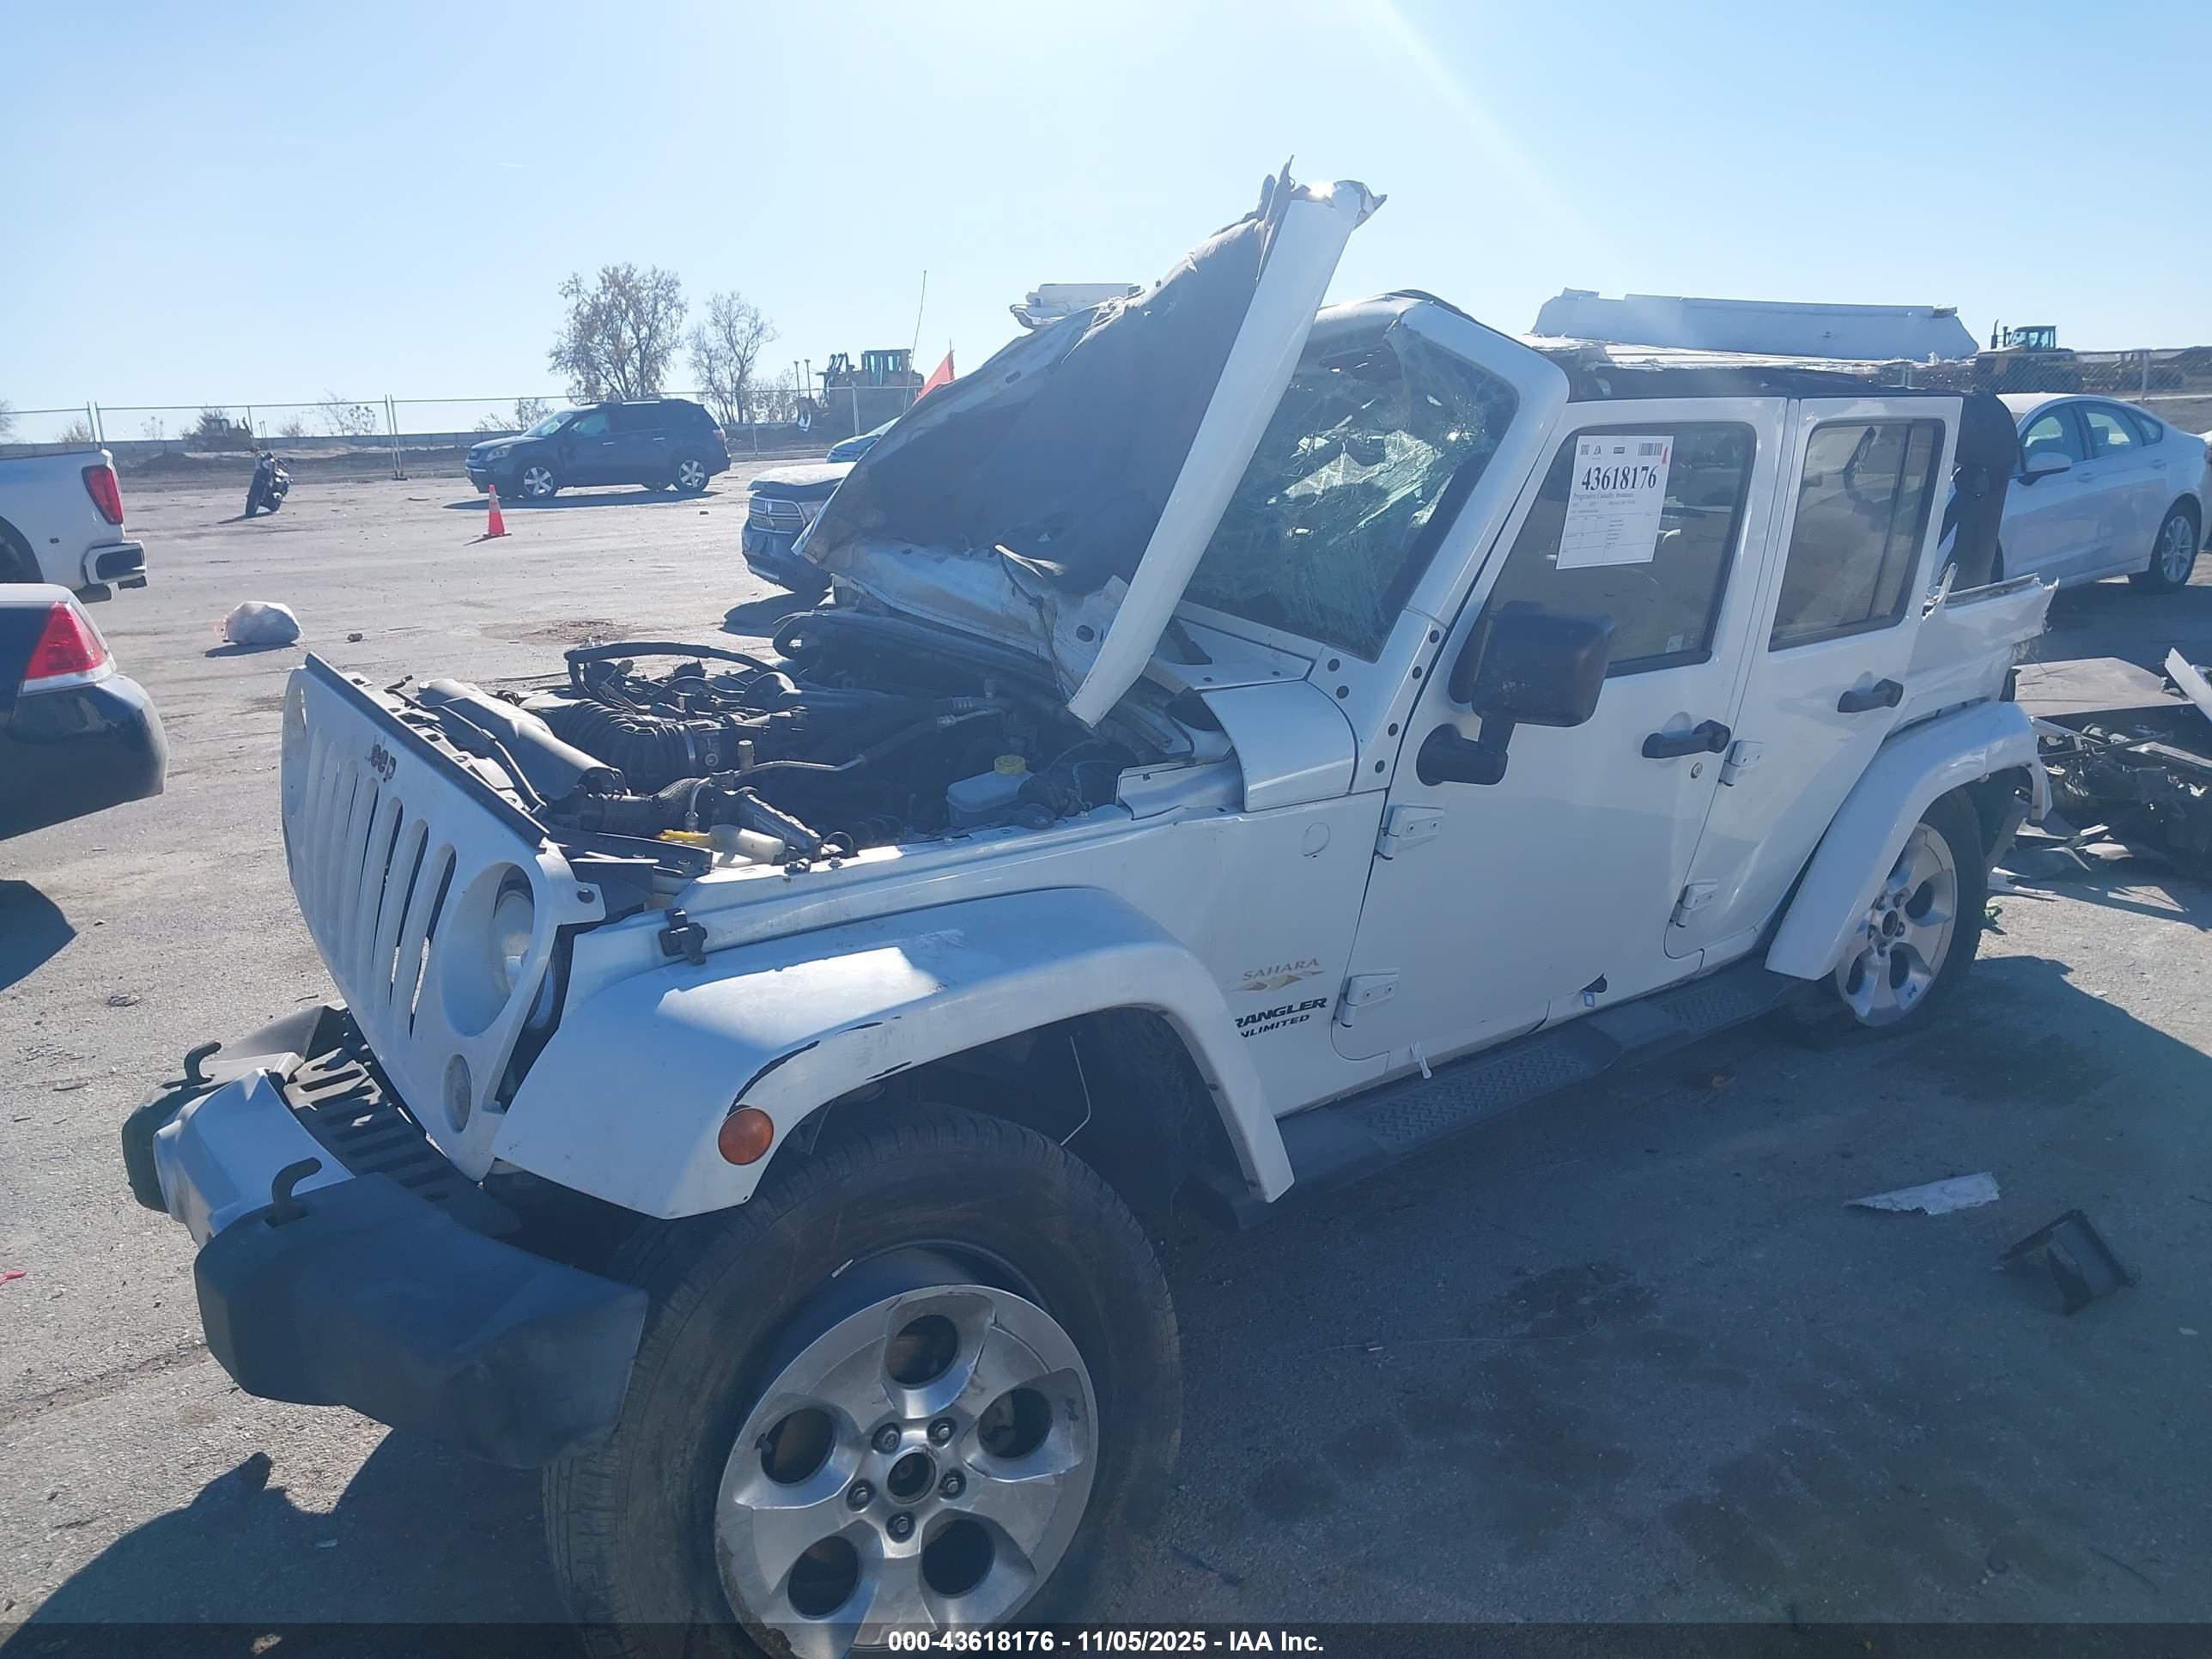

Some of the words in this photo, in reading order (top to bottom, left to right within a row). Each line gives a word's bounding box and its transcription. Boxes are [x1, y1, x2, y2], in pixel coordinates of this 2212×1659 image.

[1582, 465, 1658, 490] 43618176
[1243, 957, 1320, 981] SAHARA
[1235, 997, 1328, 1029] RANGLER
[1240, 1014, 1310, 1038] NLIMITED
